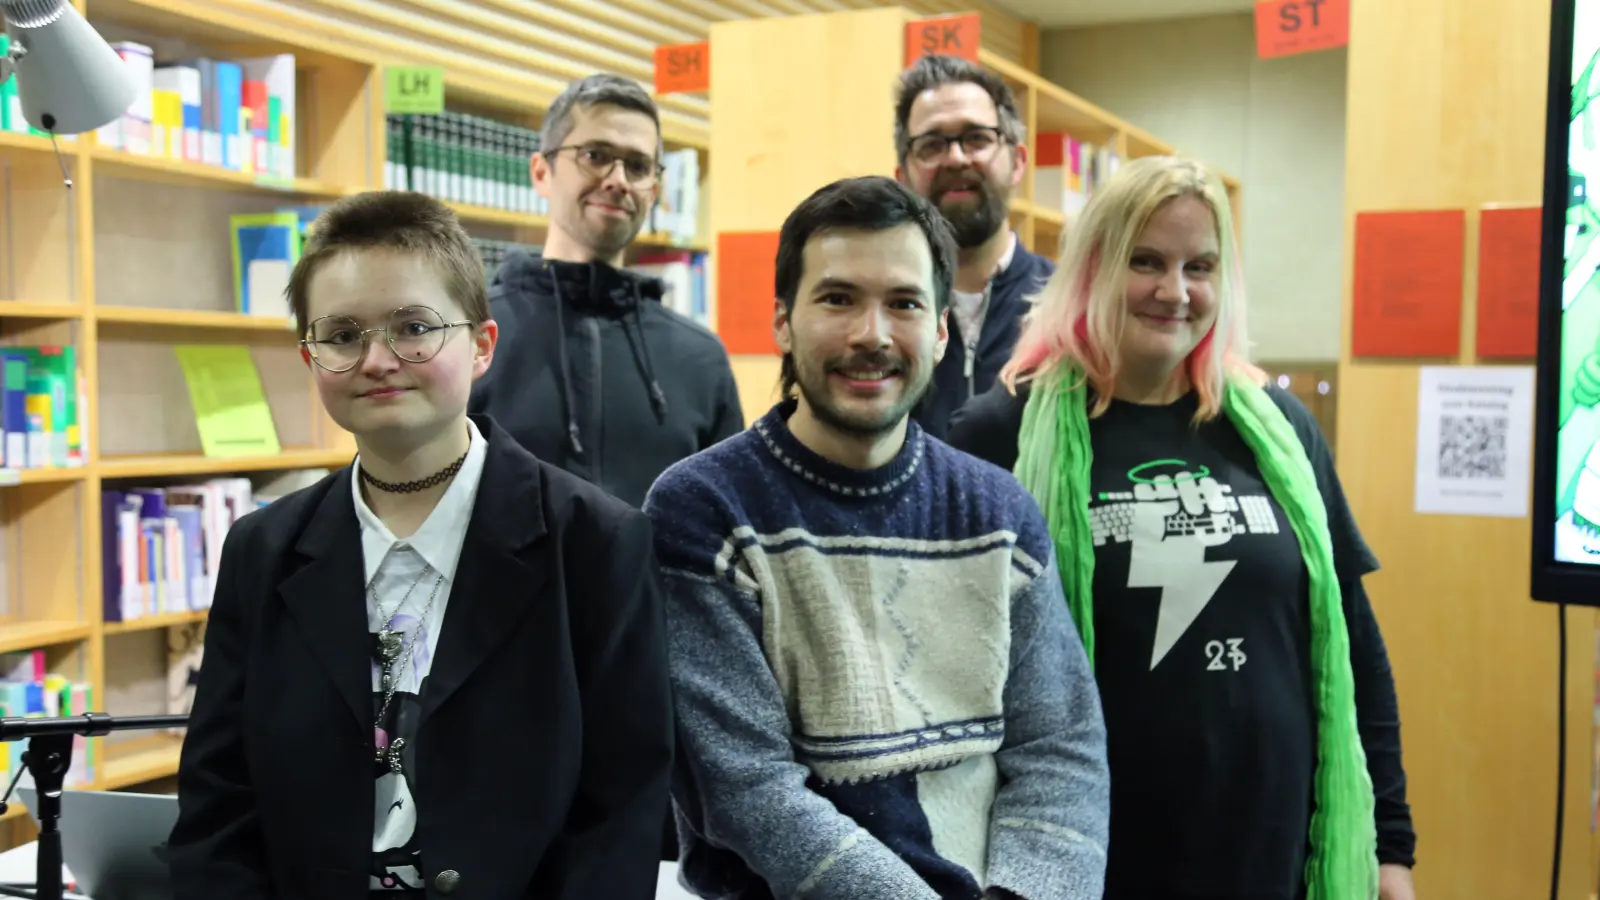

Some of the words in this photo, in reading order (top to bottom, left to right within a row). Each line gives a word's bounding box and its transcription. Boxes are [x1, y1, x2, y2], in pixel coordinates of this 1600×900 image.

[1279, 0, 1326, 32] ST
[922, 22, 962, 52] SK
[667, 49, 701, 77] SH
[398, 71, 430, 97] LH
